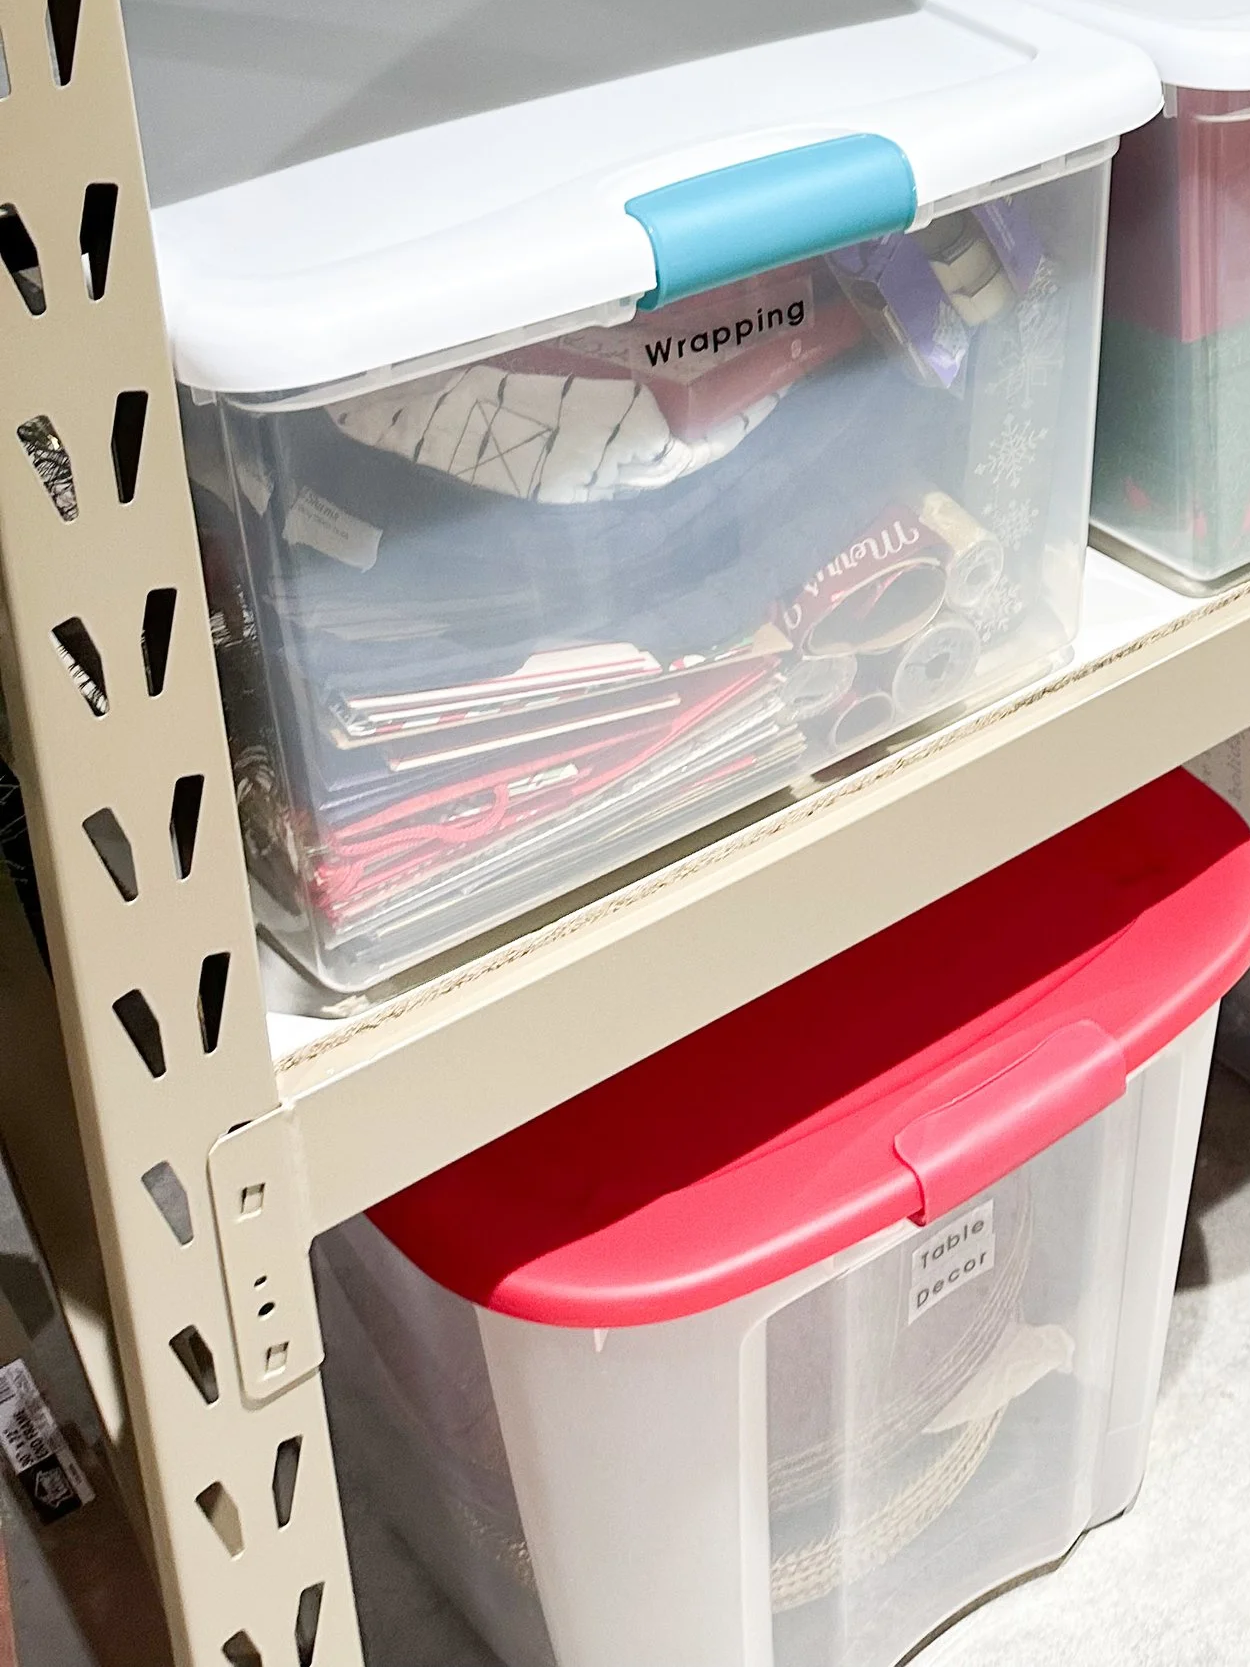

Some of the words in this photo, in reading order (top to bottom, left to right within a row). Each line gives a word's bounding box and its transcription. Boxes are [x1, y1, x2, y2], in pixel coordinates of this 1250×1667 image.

[645, 298, 806, 367] Wrapping
[920, 1219, 985, 1270] Table
[917, 1251, 987, 1309] Decor
